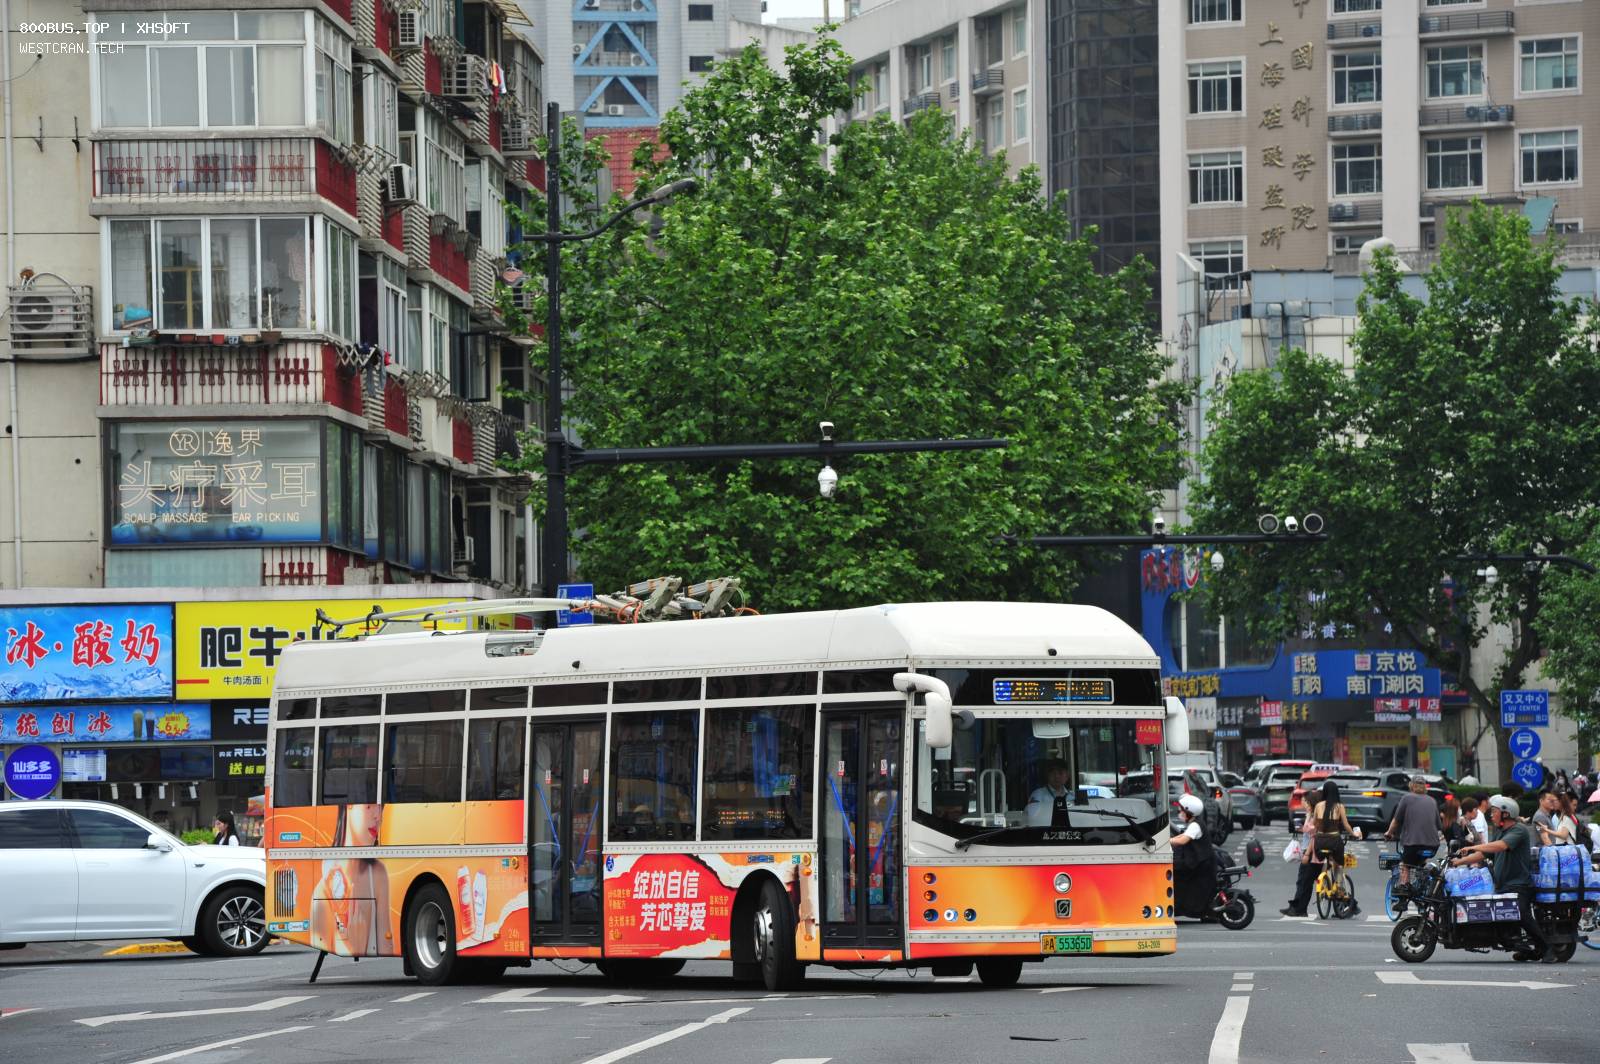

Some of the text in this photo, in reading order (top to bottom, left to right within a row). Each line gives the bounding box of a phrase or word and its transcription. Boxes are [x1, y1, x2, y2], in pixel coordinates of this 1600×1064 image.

[207, 428, 264, 457] 逸界
[119, 460, 316, 508] 头疗采耳
[124, 512, 300, 523] SCALP MASSAGE EAR PICKING
[6, 619, 161, 669] 冰·酸奶
[200, 626, 336, 668] 肥牛
[1376, 652, 1417, 672] 京悦
[223, 676, 262, 685] 牛肉汤面
[1346, 675, 1424, 694] 南门涮肉
[1504, 694, 1545, 704] 又又中心
[0, 711, 112, 736] 统刨冰
[633, 870, 700, 899] 绽放自信
[640, 902, 706, 931] 芳芯挚爱
[1059, 937, 1091, 950] 55365D
